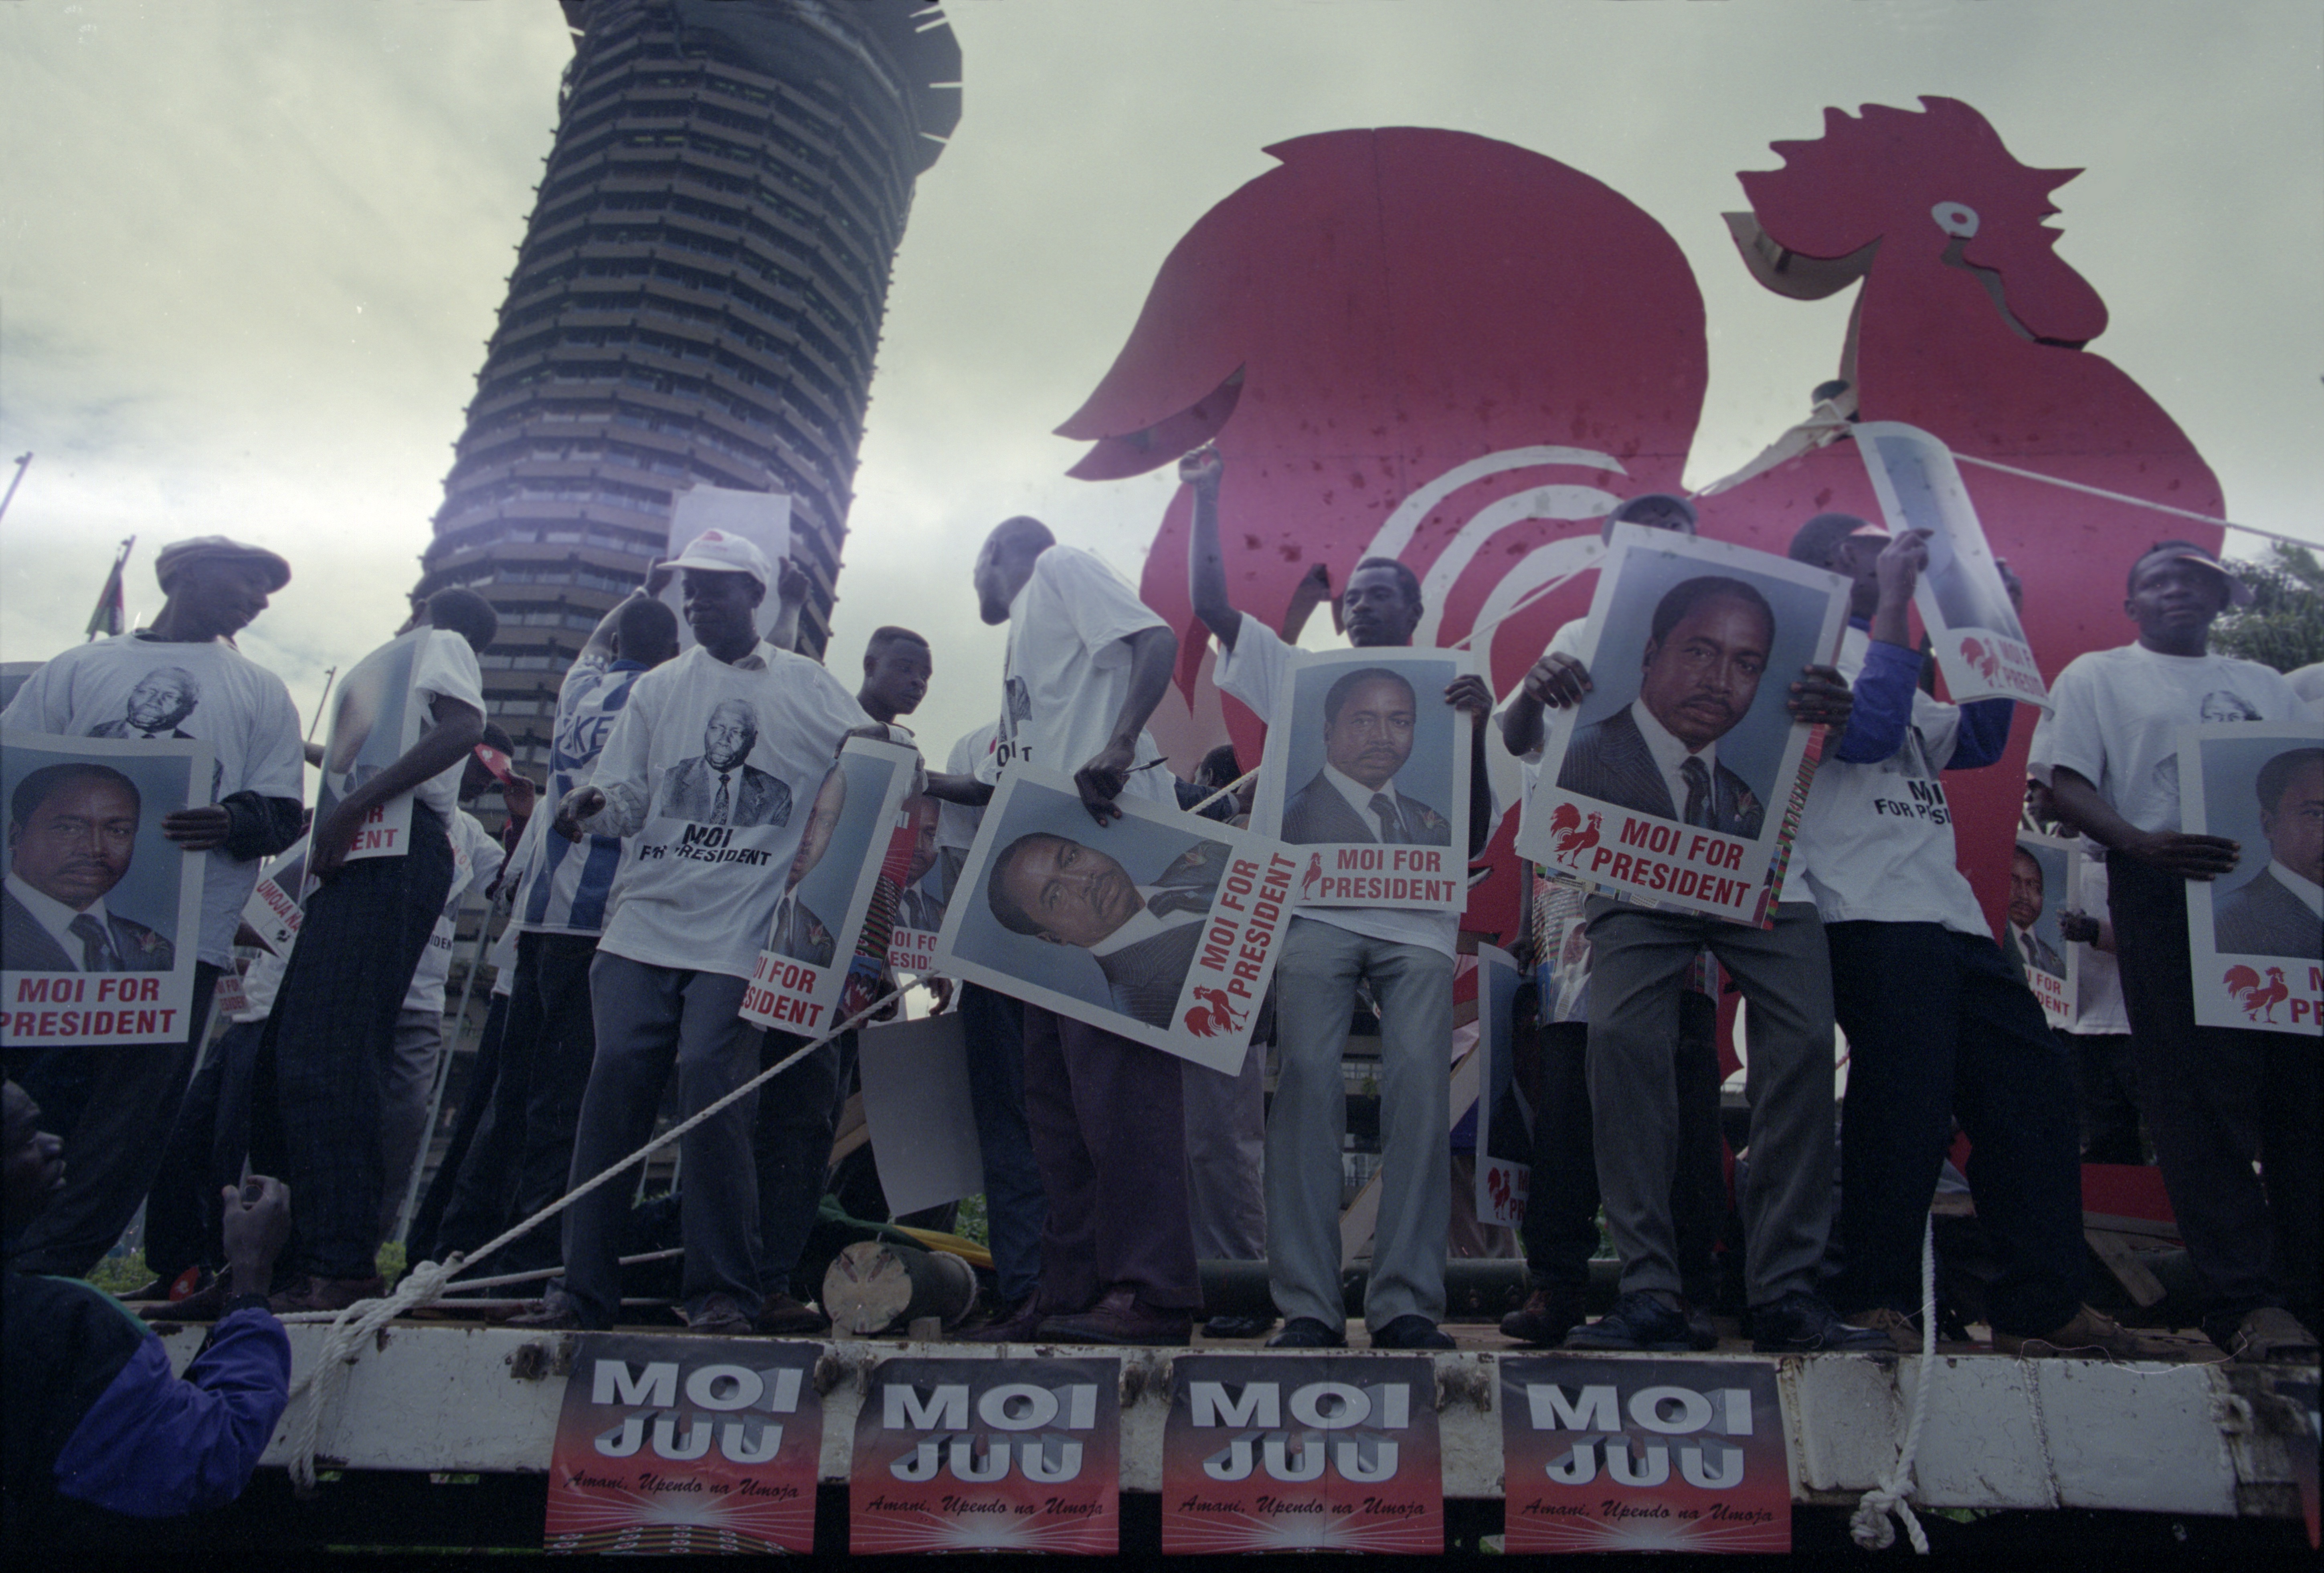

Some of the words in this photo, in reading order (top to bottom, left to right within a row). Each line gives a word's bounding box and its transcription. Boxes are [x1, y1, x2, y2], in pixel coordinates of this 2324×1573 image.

[1874, 798, 1914, 818] FOR
[682, 823, 734, 848] MOI
[1620, 817, 1680, 856] MOI
[1688, 835, 1744, 871] FOR
[1337, 849, 1384, 870] MOI
[1394, 850, 1441, 872] FOR
[1590, 846, 1751, 908] PRESIDENT
[256, 879, 293, 919] UMOJA
[1320, 877, 1456, 902] PRESIDENT
[1199, 916, 1239, 973] MOI
[1220, 859, 1260, 912] FOR
[1227, 852, 1297, 999] PRESIDENT
[918, 934, 937, 952] FO
[17, 978, 85, 1003] MOI
[97, 978, 160, 1002] FOR
[752, 956, 768, 979] OI
[768, 960, 817, 994] FOR
[2036, 973, 2061, 995] FOR
[592, 1359, 804, 1413] MOI
[1189, 1381, 1410, 1429] MOI
[883, 1383, 1098, 1431] MOI
[1526, 1383, 1754, 1436] MOI
[594, 1410, 784, 1463] JUU
[1203, 1431, 1399, 1482] JUU
[889, 1434, 1083, 1482] JUU
[1544, 1434, 1744, 1489] JUU
[639, 1473, 702, 1495] Upendo
[710, 1483, 730, 1494] na
[740, 1478, 800, 1501] Umoja
[942, 1496, 1007, 1517] Upendo
[1015, 1503, 1035, 1514] na
[1045, 1497, 1104, 1518] Umoja
[1256, 1496, 1324, 1517] Upendo
[1332, 1503, 1353, 1514] na
[1363, 1497, 1426, 1519] Umoja
[1601, 1500, 1671, 1521] Upendo
[1678, 1509, 1700, 1520] na
[1711, 1503, 1774, 1524] Umoja
